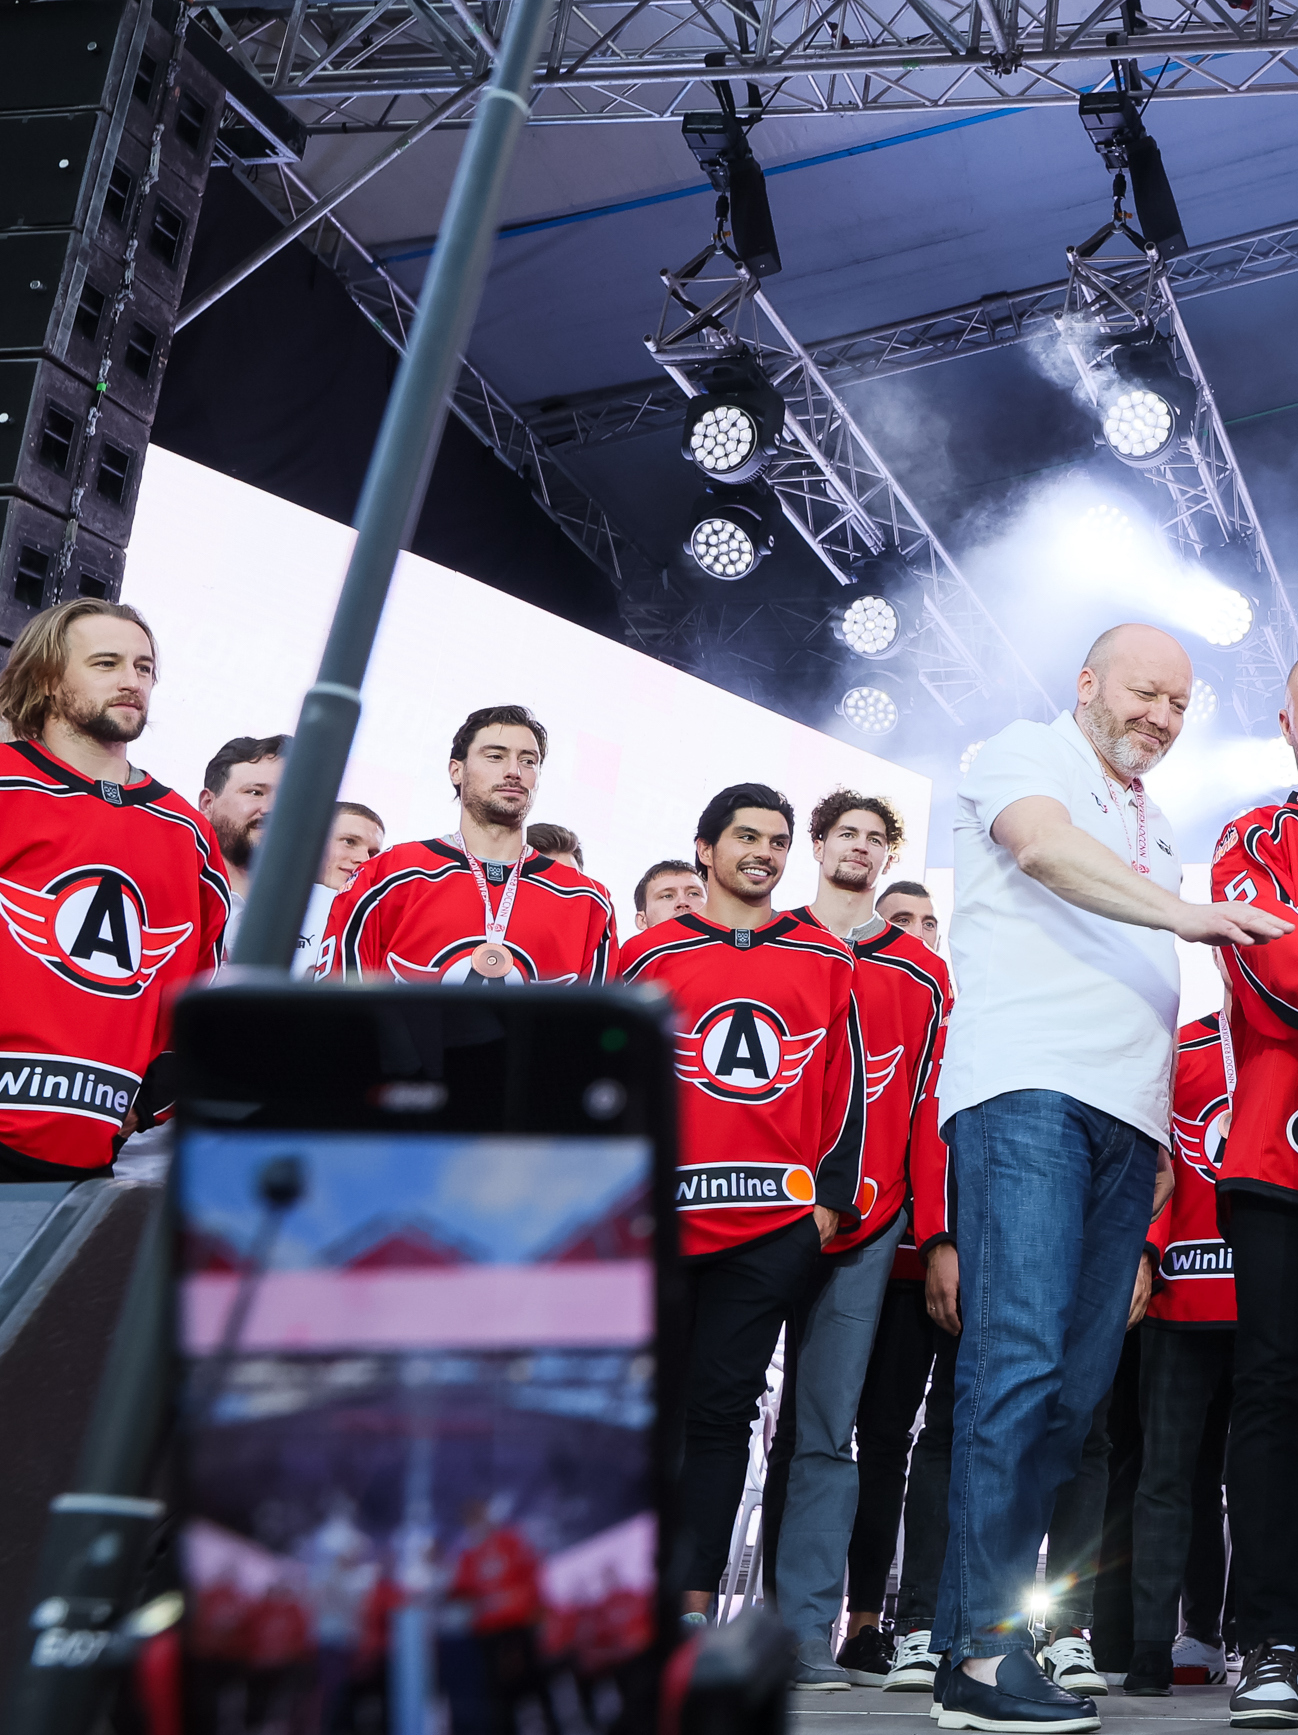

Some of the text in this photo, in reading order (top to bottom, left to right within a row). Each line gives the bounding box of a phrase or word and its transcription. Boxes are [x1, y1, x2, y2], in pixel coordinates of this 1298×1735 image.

[69, 872, 135, 974] A
[313, 935, 337, 983] 9
[715, 1001, 770, 1080] A
[1171, 1247, 1233, 1271] Winli
